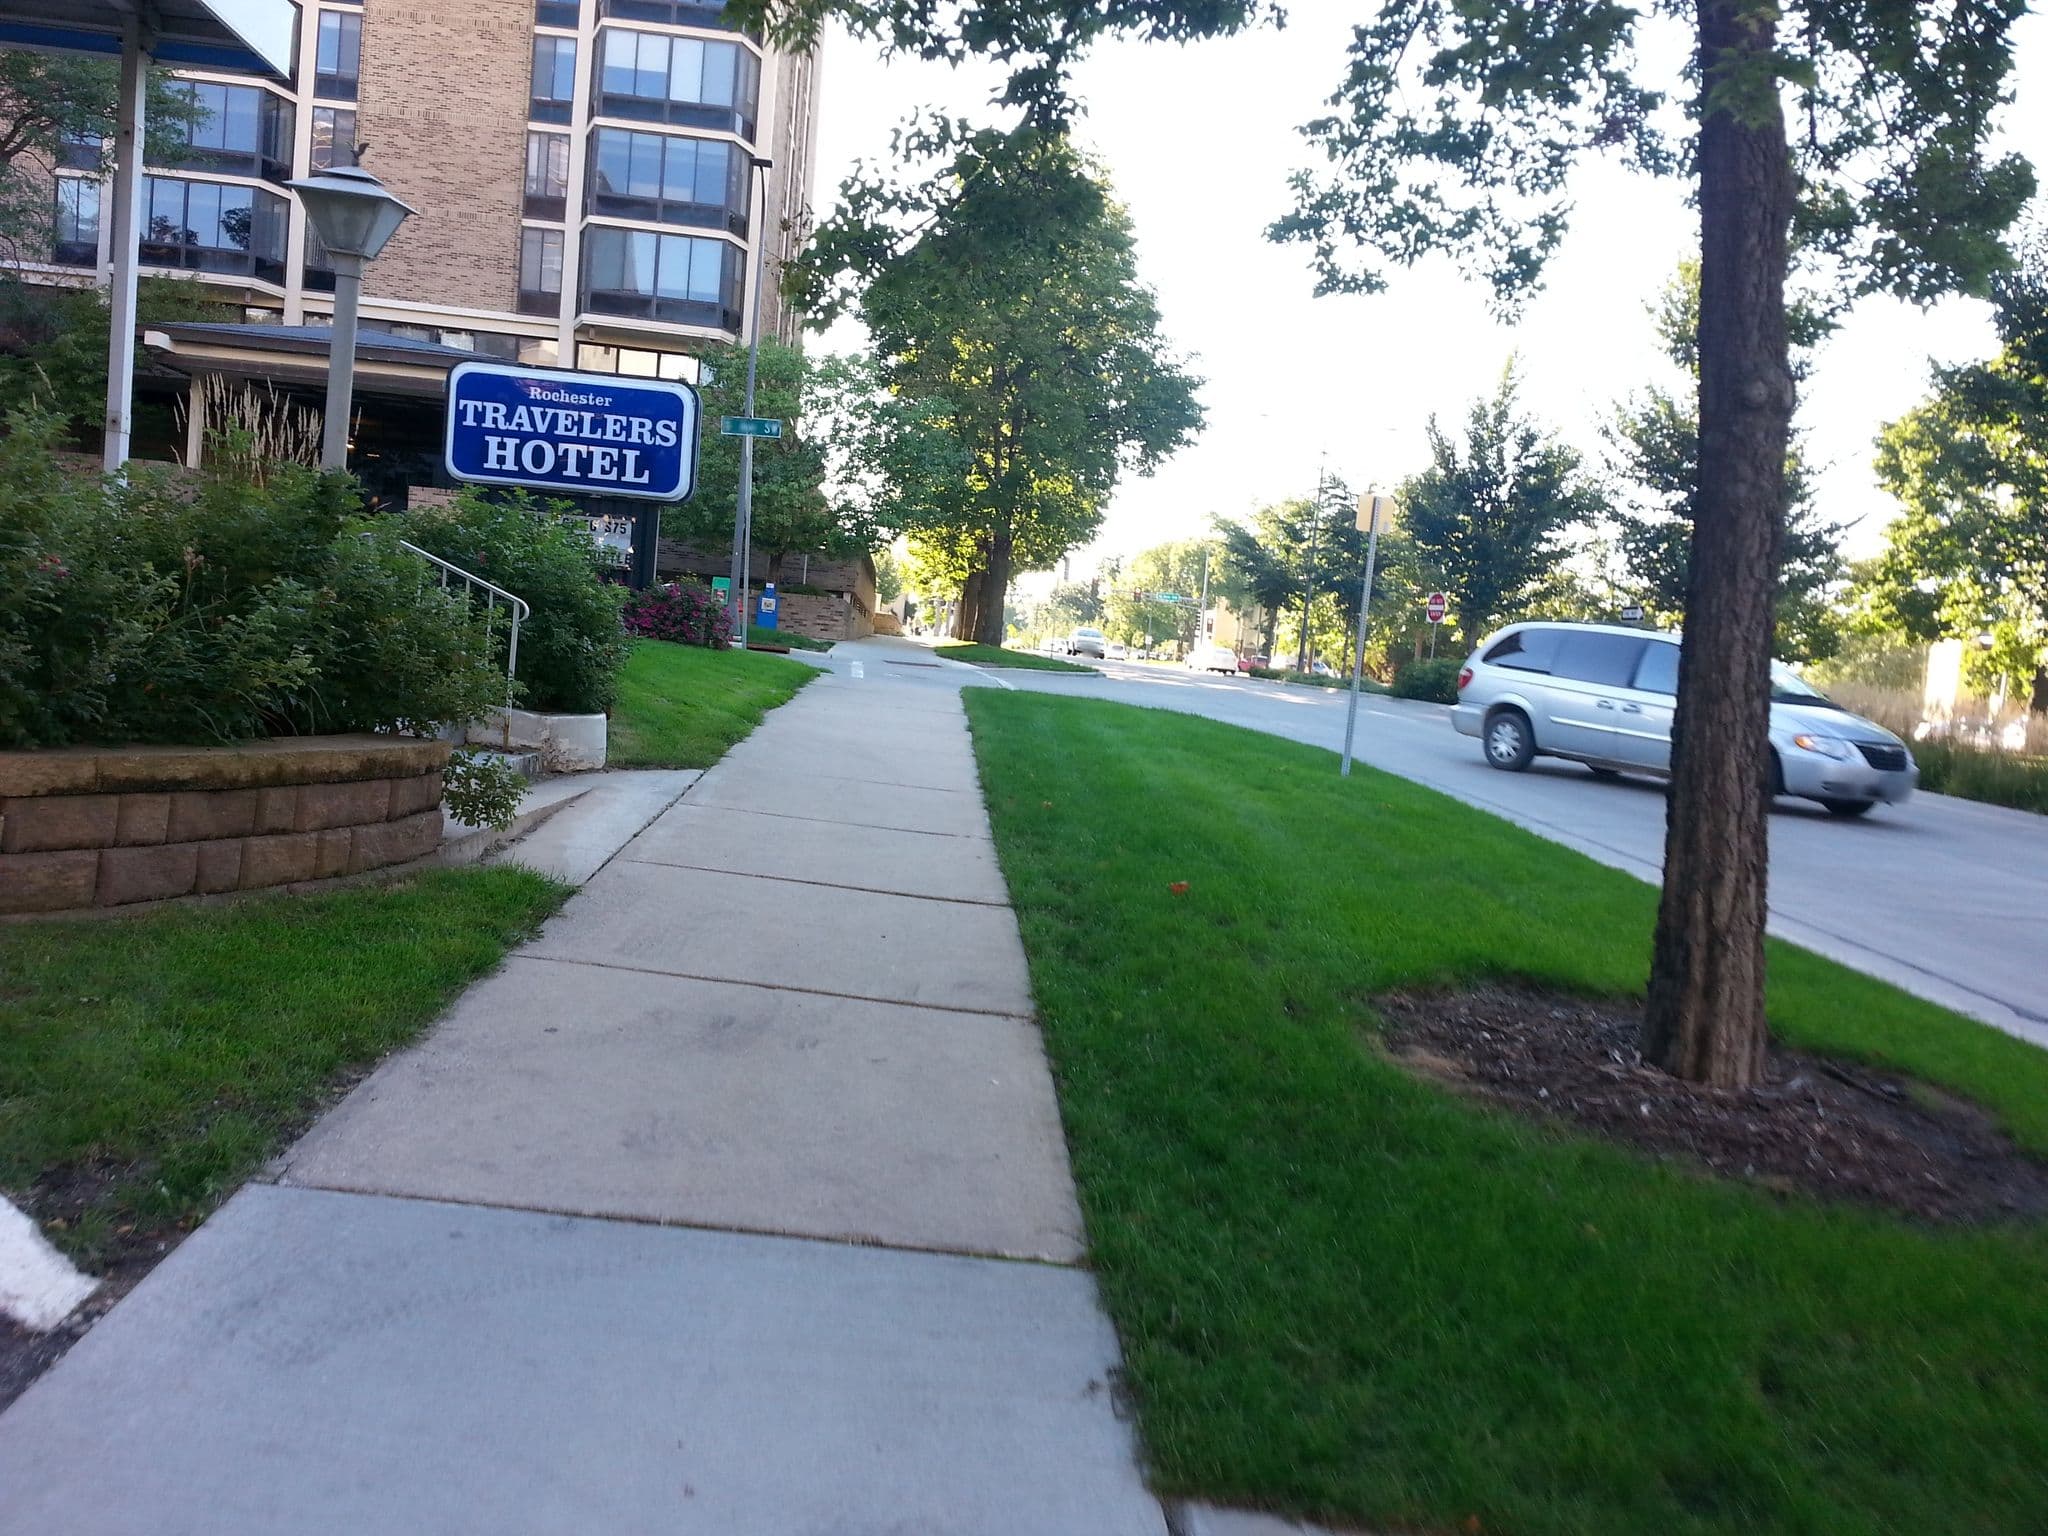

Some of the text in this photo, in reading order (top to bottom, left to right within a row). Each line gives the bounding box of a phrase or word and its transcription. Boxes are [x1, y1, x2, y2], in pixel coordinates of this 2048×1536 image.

[529, 386, 613, 407] Rochester
[458, 399, 678, 447] TRAVELERS
[483, 435, 650, 484] HOTEL
